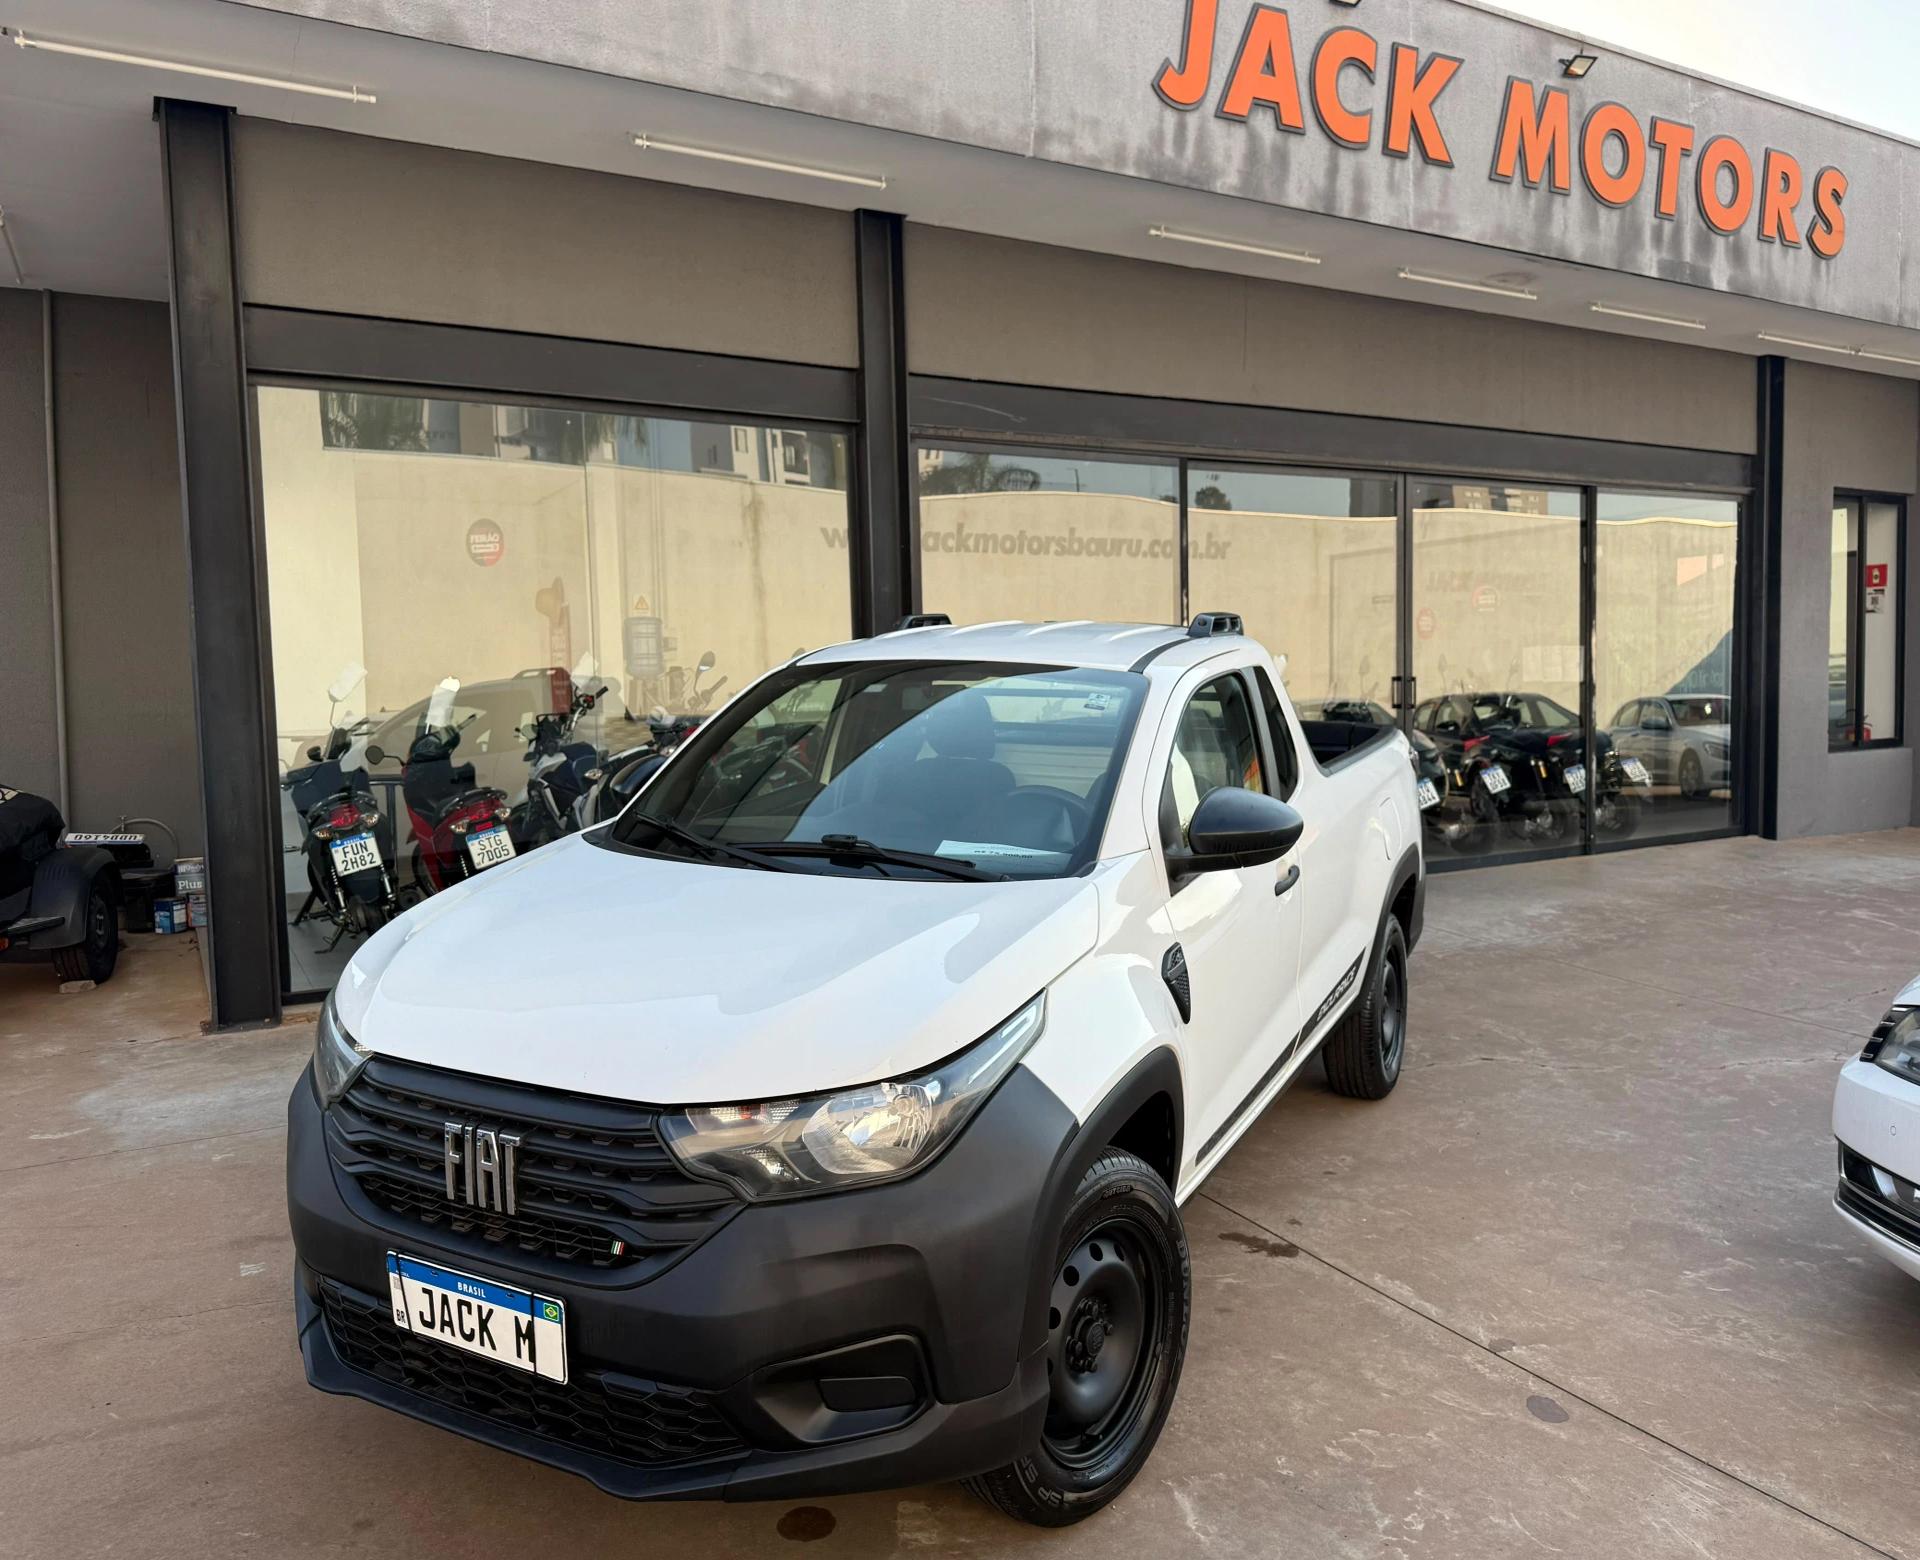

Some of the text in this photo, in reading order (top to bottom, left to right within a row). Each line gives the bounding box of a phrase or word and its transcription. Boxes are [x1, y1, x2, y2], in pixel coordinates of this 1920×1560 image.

[1153, 0, 1849, 260] JACK MOTORS
[342, 841, 369, 859] FUN
[479, 834, 502, 851] STG
[341, 853, 377, 872] 2H82
[477, 846, 510, 864] 7D05
[178, 880, 203, 890] Plus
[445, 1122, 520, 1216] FIAT
[457, 1281, 486, 1299] BRASIL
[396, 1309, 406, 1324] BR
[418, 1287, 536, 1364] JACK M
